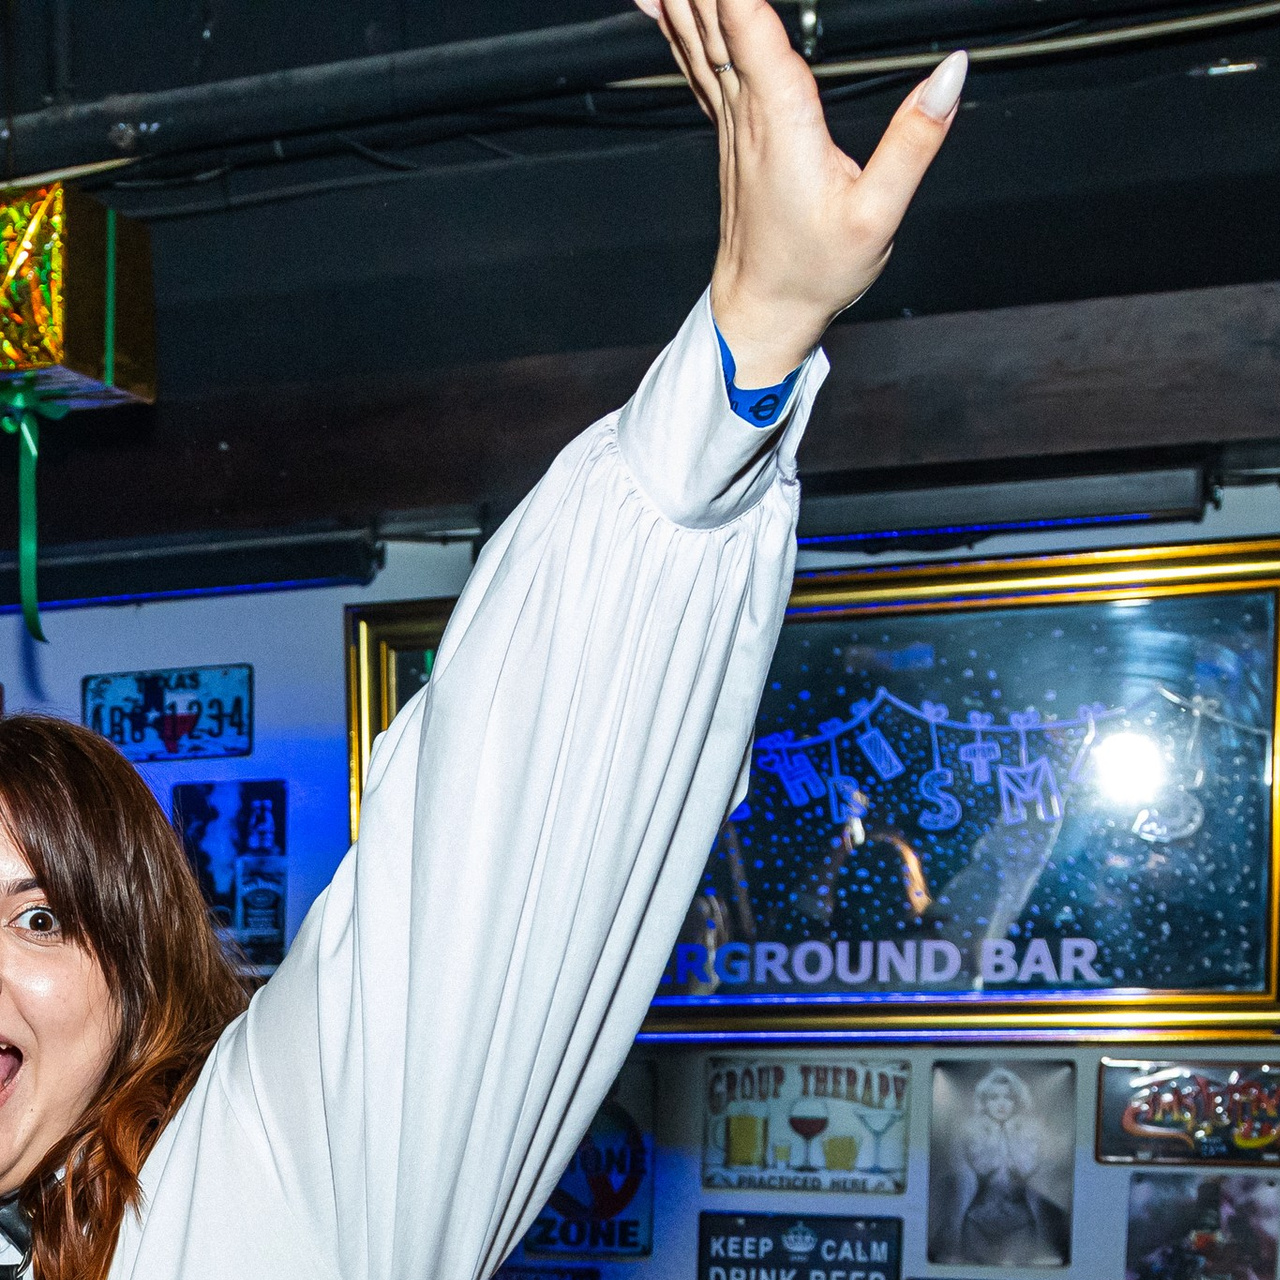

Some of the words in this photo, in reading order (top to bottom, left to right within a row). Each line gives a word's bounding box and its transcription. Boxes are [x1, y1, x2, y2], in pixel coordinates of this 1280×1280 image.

[981, 936, 1099, 984] BAR
[709, 1064, 786, 1116] GROUP
[799, 1064, 909, 1111] THERAPY
[534, 1217, 640, 1248] ZONE
[709, 1235, 774, 1260] KEEP
[821, 1238, 889, 1264] CALM
